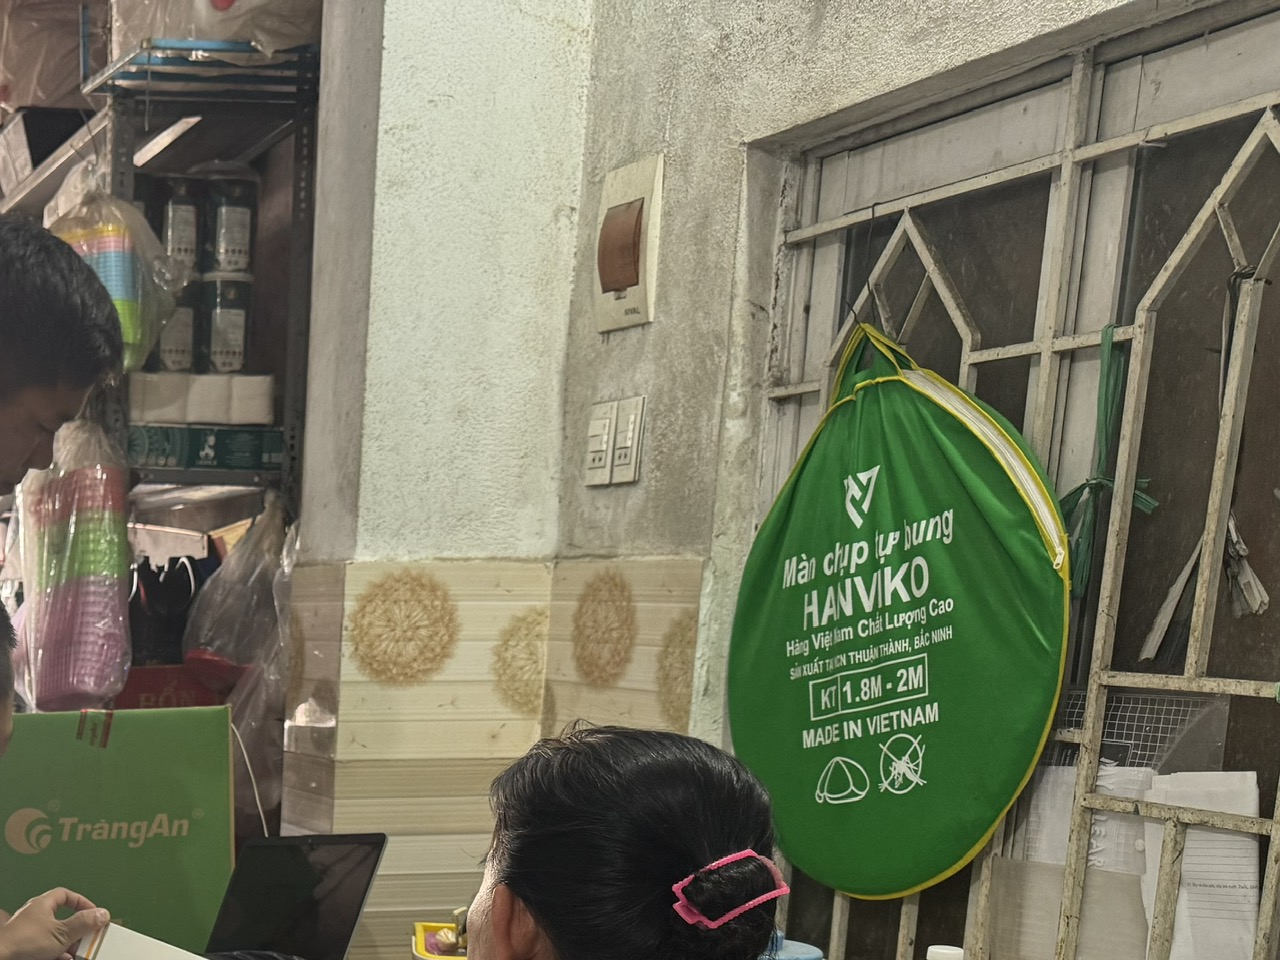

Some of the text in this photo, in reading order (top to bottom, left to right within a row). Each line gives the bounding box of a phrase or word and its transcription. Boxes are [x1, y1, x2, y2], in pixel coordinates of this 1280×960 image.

[782, 509, 953, 589] Màn chụp tự bung
[803, 556, 929, 630] HANVIKO
[885, 605, 926, 629] Lượng
[929, 598, 954, 616] Cao
[931, 624, 953, 645] NINH
[821, 685, 837, 710] KT
[842, 674, 882, 703] 1.8M
[896, 665, 924, 693] 2M
[802, 702, 939, 748] MADE IN VIETNAM
